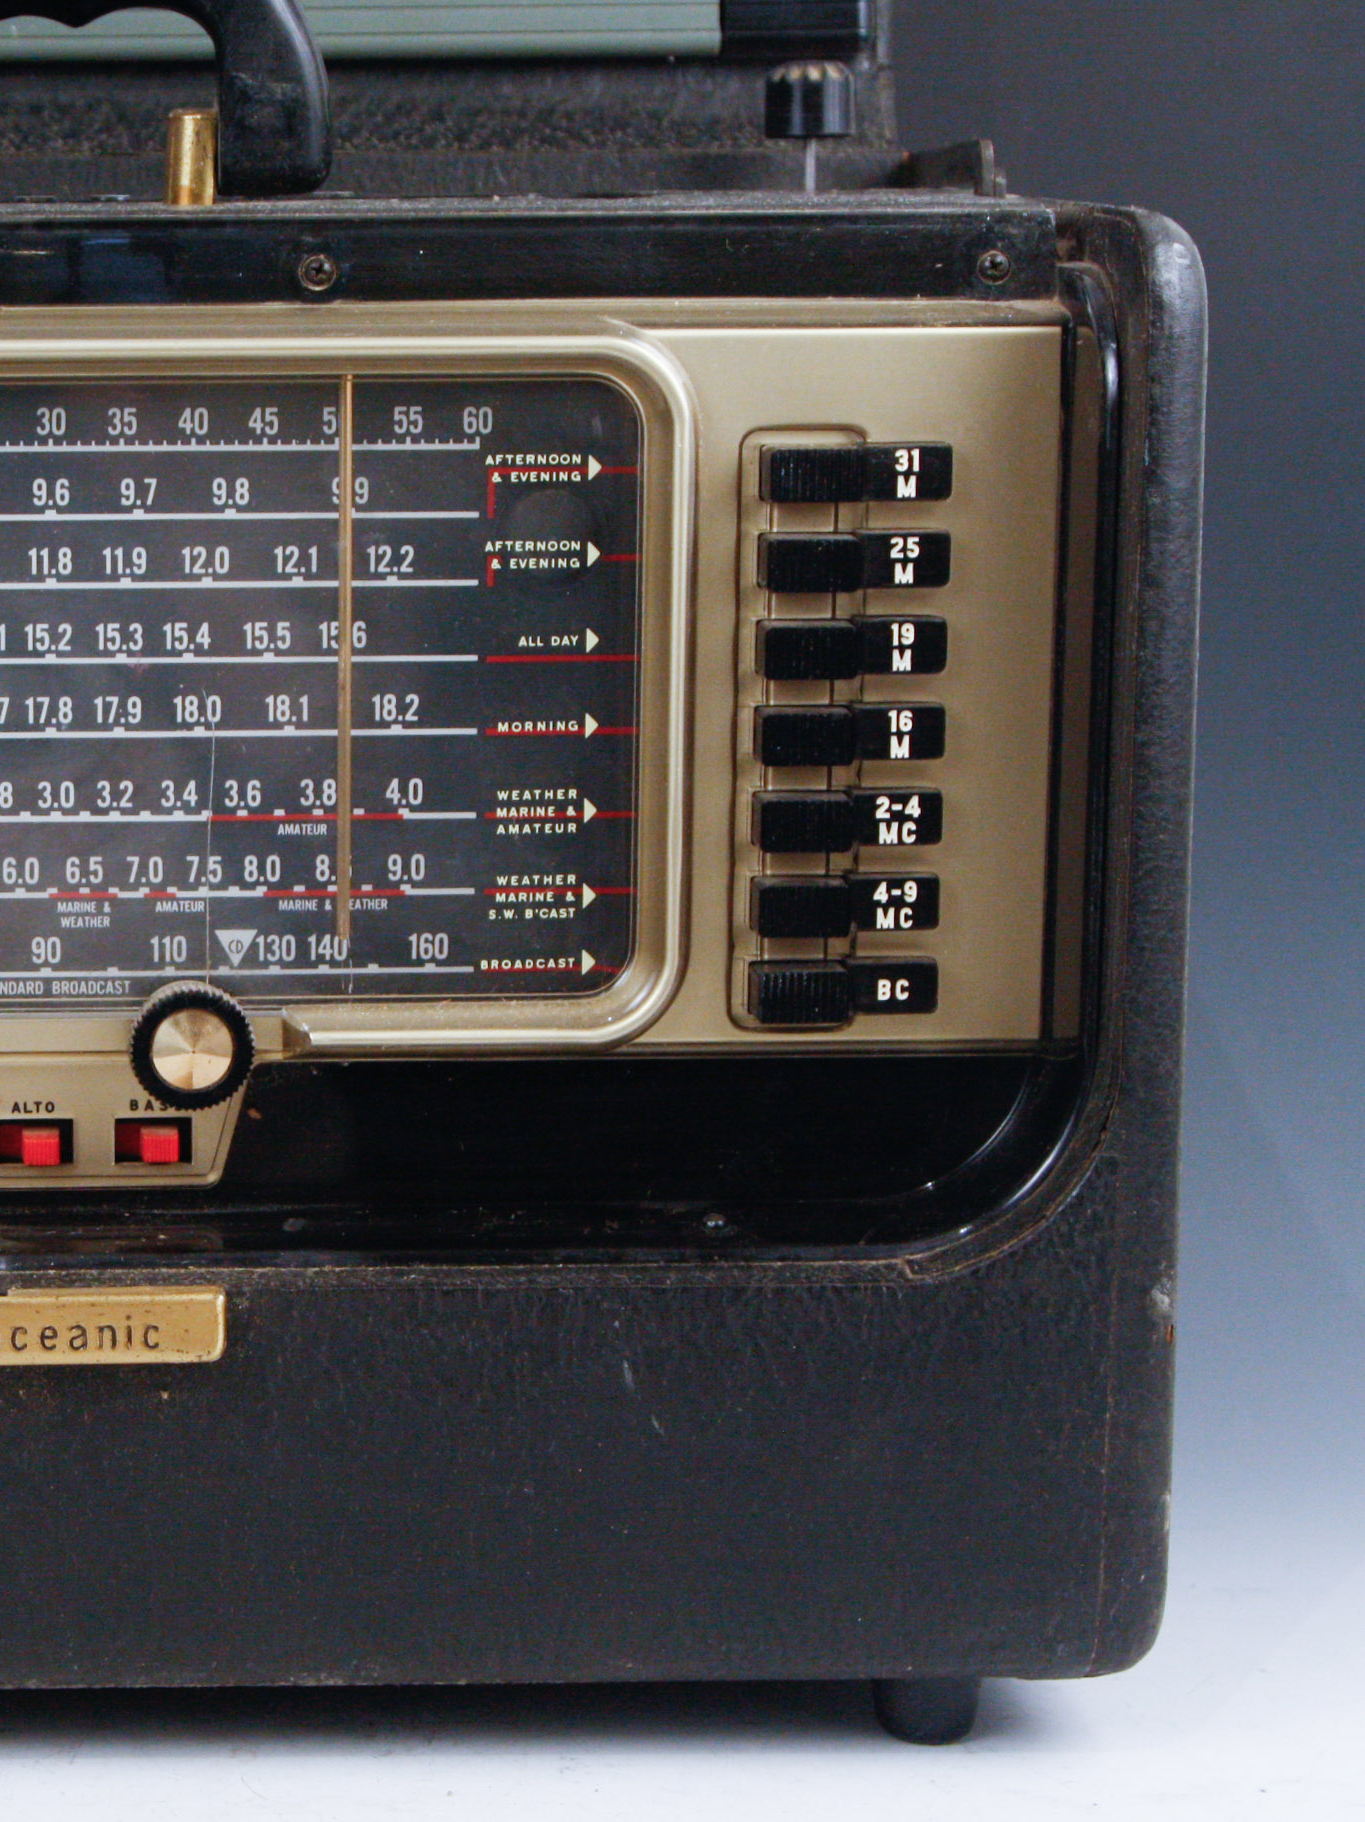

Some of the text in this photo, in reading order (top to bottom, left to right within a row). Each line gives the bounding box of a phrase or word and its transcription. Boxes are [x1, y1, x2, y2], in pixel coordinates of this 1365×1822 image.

[37, 408, 66, 435] 30
[108, 408, 137, 435] 35
[179, 408, 208, 435] 40
[249, 408, 278, 434] 45
[322, 406, 340, 435] 5
[394, 407, 423, 433] 55
[463, 407, 492, 434] 60
[486, 454, 581, 465] AFTERNOON
[895, 449, 919, 471] 31
[492, 471, 580, 482] & EVENING
[33, 478, 69, 505] 9.6
[121, 478, 157, 505] 9.7
[213, 478, 249, 505] 9.8
[331, 476, 369, 505] 99
[897, 476, 916, 498] M
[485, 541, 580, 551] AFTERNOON
[891, 537, 919, 558] 25
[29, 547, 72, 575] 11.8
[103, 547, 146, 574] 11.9
[182, 546, 229, 573] 12.0
[274, 546, 317, 573] 12.1
[367, 545, 414, 572] 12.2
[491, 558, 579, 569] & EVENING
[895, 563, 913, 584] M
[25, 623, 72, 650] 15.2
[96, 623, 143, 650] 15.3
[163, 622, 211, 650] 15.4
[243, 622, 290, 649] 15.5
[318, 620, 367, 649] 156
[519, 635, 578, 646] ALL DAY
[892, 623, 914, 646] 19
[893, 649, 911, 671] M
[25, 696, 72, 724] 17.8
[94, 696, 141, 723] 17.9
[174, 695, 221, 725] 18.0
[265, 695, 308, 722] 18.1
[372, 694, 419, 721] 18.2
[498, 721, 578, 732] MORNING
[888, 710, 912, 732] 16
[890, 735, 909, 758] M
[38, 781, 74, 808] 3.0
[97, 781, 133, 807] 3.2
[161, 780, 198, 807] 3.4
[225, 780, 261, 807] 3.6
[300, 779, 336, 806] 3.8
[386, 778, 422, 804] 4.0
[497, 789, 576, 800] WEATHER
[497, 806, 576, 817] MARINE &
[876, 796, 921, 818] 2-4
[278, 824, 327, 835] AMATEUR
[497, 823, 576, 834] AMATEUR
[879, 822, 916, 844] MC
[3, 857, 39, 884] 6.0
[66, 857, 103, 883] 6.5
[127, 856, 163, 883] 7.0
[186, 856, 222, 883] 7.5
[244, 855, 280, 882] 8.0
[315, 853, 353, 882] 8.
[388, 854, 425, 881] 9.0
[497, 875, 575, 885] WEATHER
[496, 891, 575, 902] MARINE &
[873, 881, 917, 903] 4-9
[58, 902, 110, 913] MARINE &
[156, 901, 204, 912] AMATEUR
[279, 898, 389, 910] MARINE & EATHER
[488, 908, 575, 920] S.W. B'CAST
[61, 916, 110, 927] WEATHER
[877, 908, 912, 929] MC
[32, 937, 61, 963] 90
[151, 936, 186, 962] 110
[254, 933, 295, 961] 130
[307, 933, 349, 961] 140
[409, 933, 448, 959] 160
[481, 958, 574, 970] BROADCAST
[52, 981, 130, 994] BROADCAST
[878, 980, 908, 1000] BC
[12, 1101, 54, 1113] ALTO
